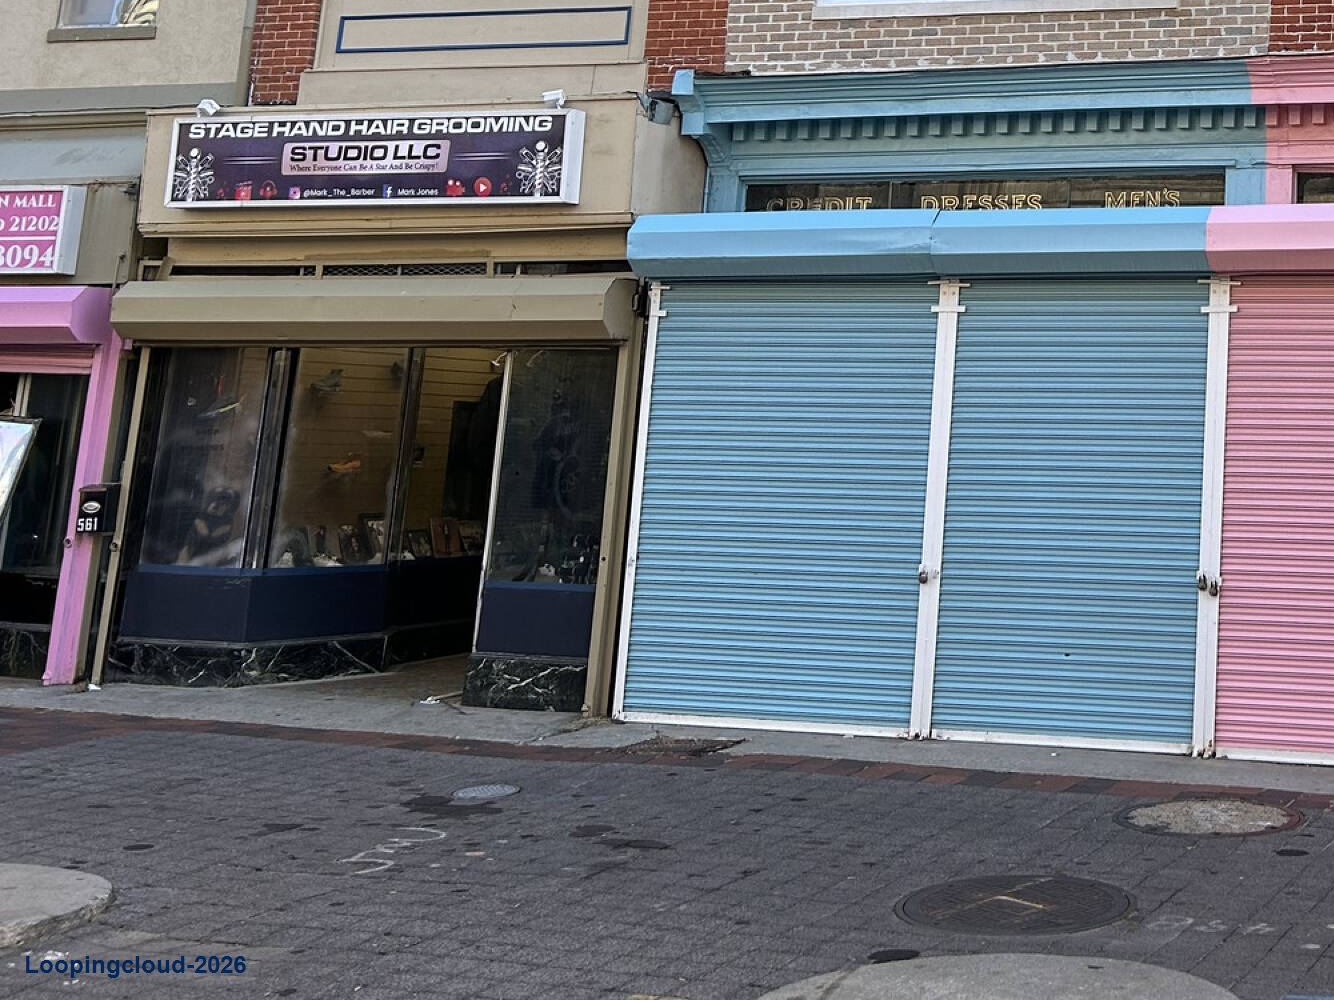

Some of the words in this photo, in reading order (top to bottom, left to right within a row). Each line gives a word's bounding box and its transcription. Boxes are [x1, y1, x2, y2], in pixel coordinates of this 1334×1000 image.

[189, 122, 269, 138] STAGE
[272, 120, 345, 137] HAND
[349, 118, 409, 135] HAIR
[413, 116, 552, 134] GROOMING
[290, 144, 388, 162] STUDIO
[393, 143, 441, 160] LLC
[289, 164, 312, 172] Where
[313, 163, 342, 172] Everyone
[344, 163, 357, 171] Can
[359, 163, 368, 171] Be
[389, 162, 402, 170] And
[405, 162, 413, 170] Be
[397, 187, 415, 196] Mark
[416, 187, 439, 196] Jones
[1104, 188, 1180, 208] MEN'S
[12, 194, 57, 208] MALL
[9, 215, 59, 231] 21202
[77, 517, 98, 531] 561
